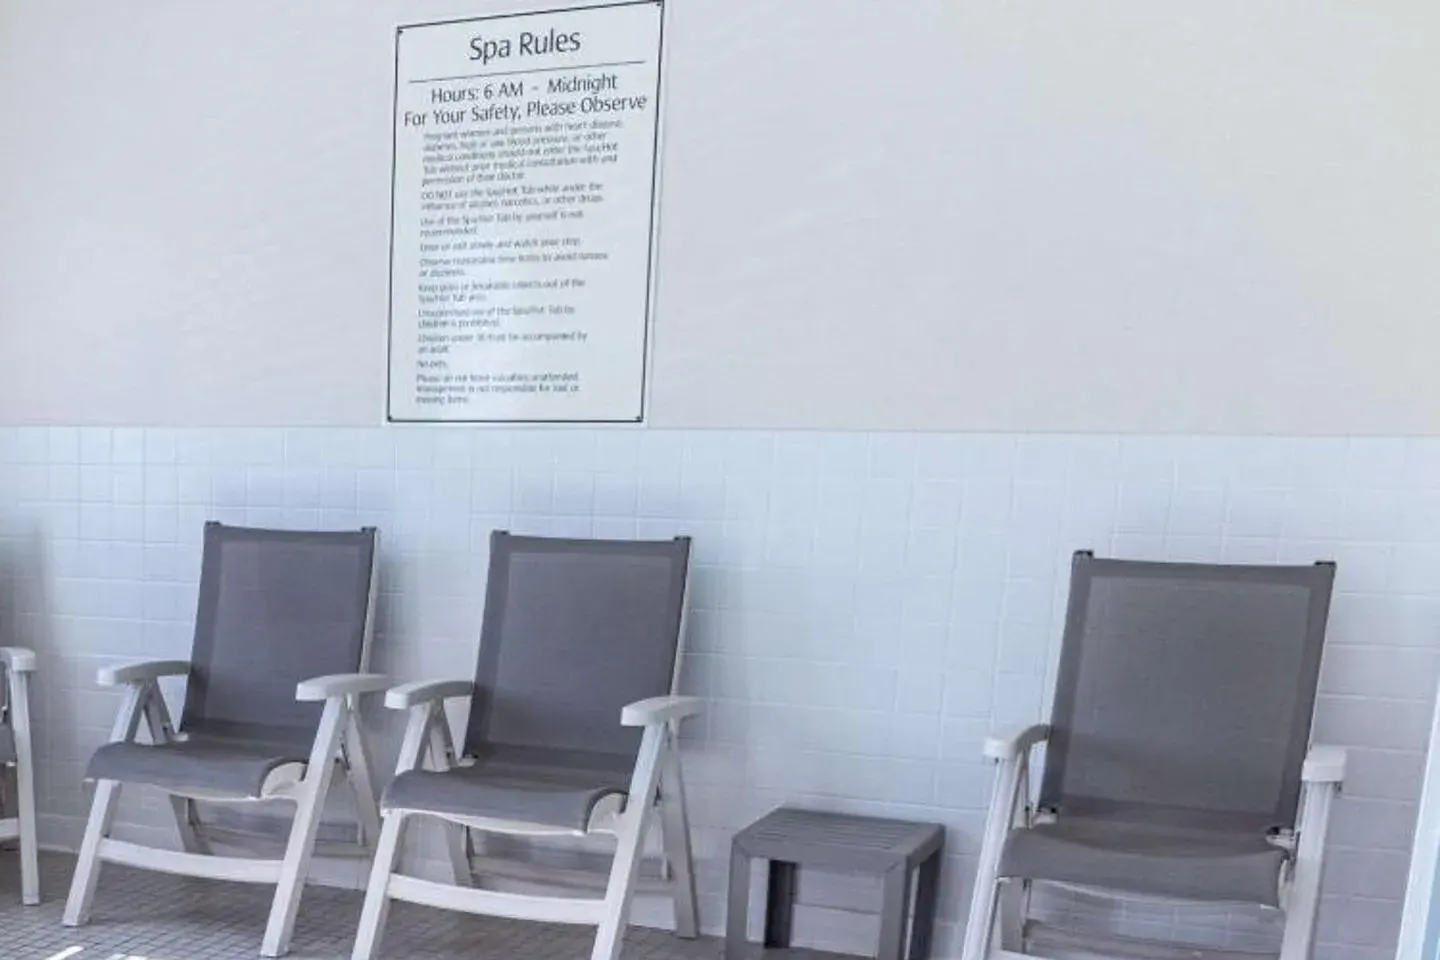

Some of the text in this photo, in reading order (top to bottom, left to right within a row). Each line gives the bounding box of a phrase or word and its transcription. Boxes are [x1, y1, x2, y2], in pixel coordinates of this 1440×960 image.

[469, 28, 581, 64] Spa Rules
[431, 88, 478, 104] Hours:
[483, 84, 494, 99] 6
[498, 82, 524, 97] AM
[547, 73, 619, 94] Midnight
[404, 94, 648, 127] For Your Safety, Please Observe
